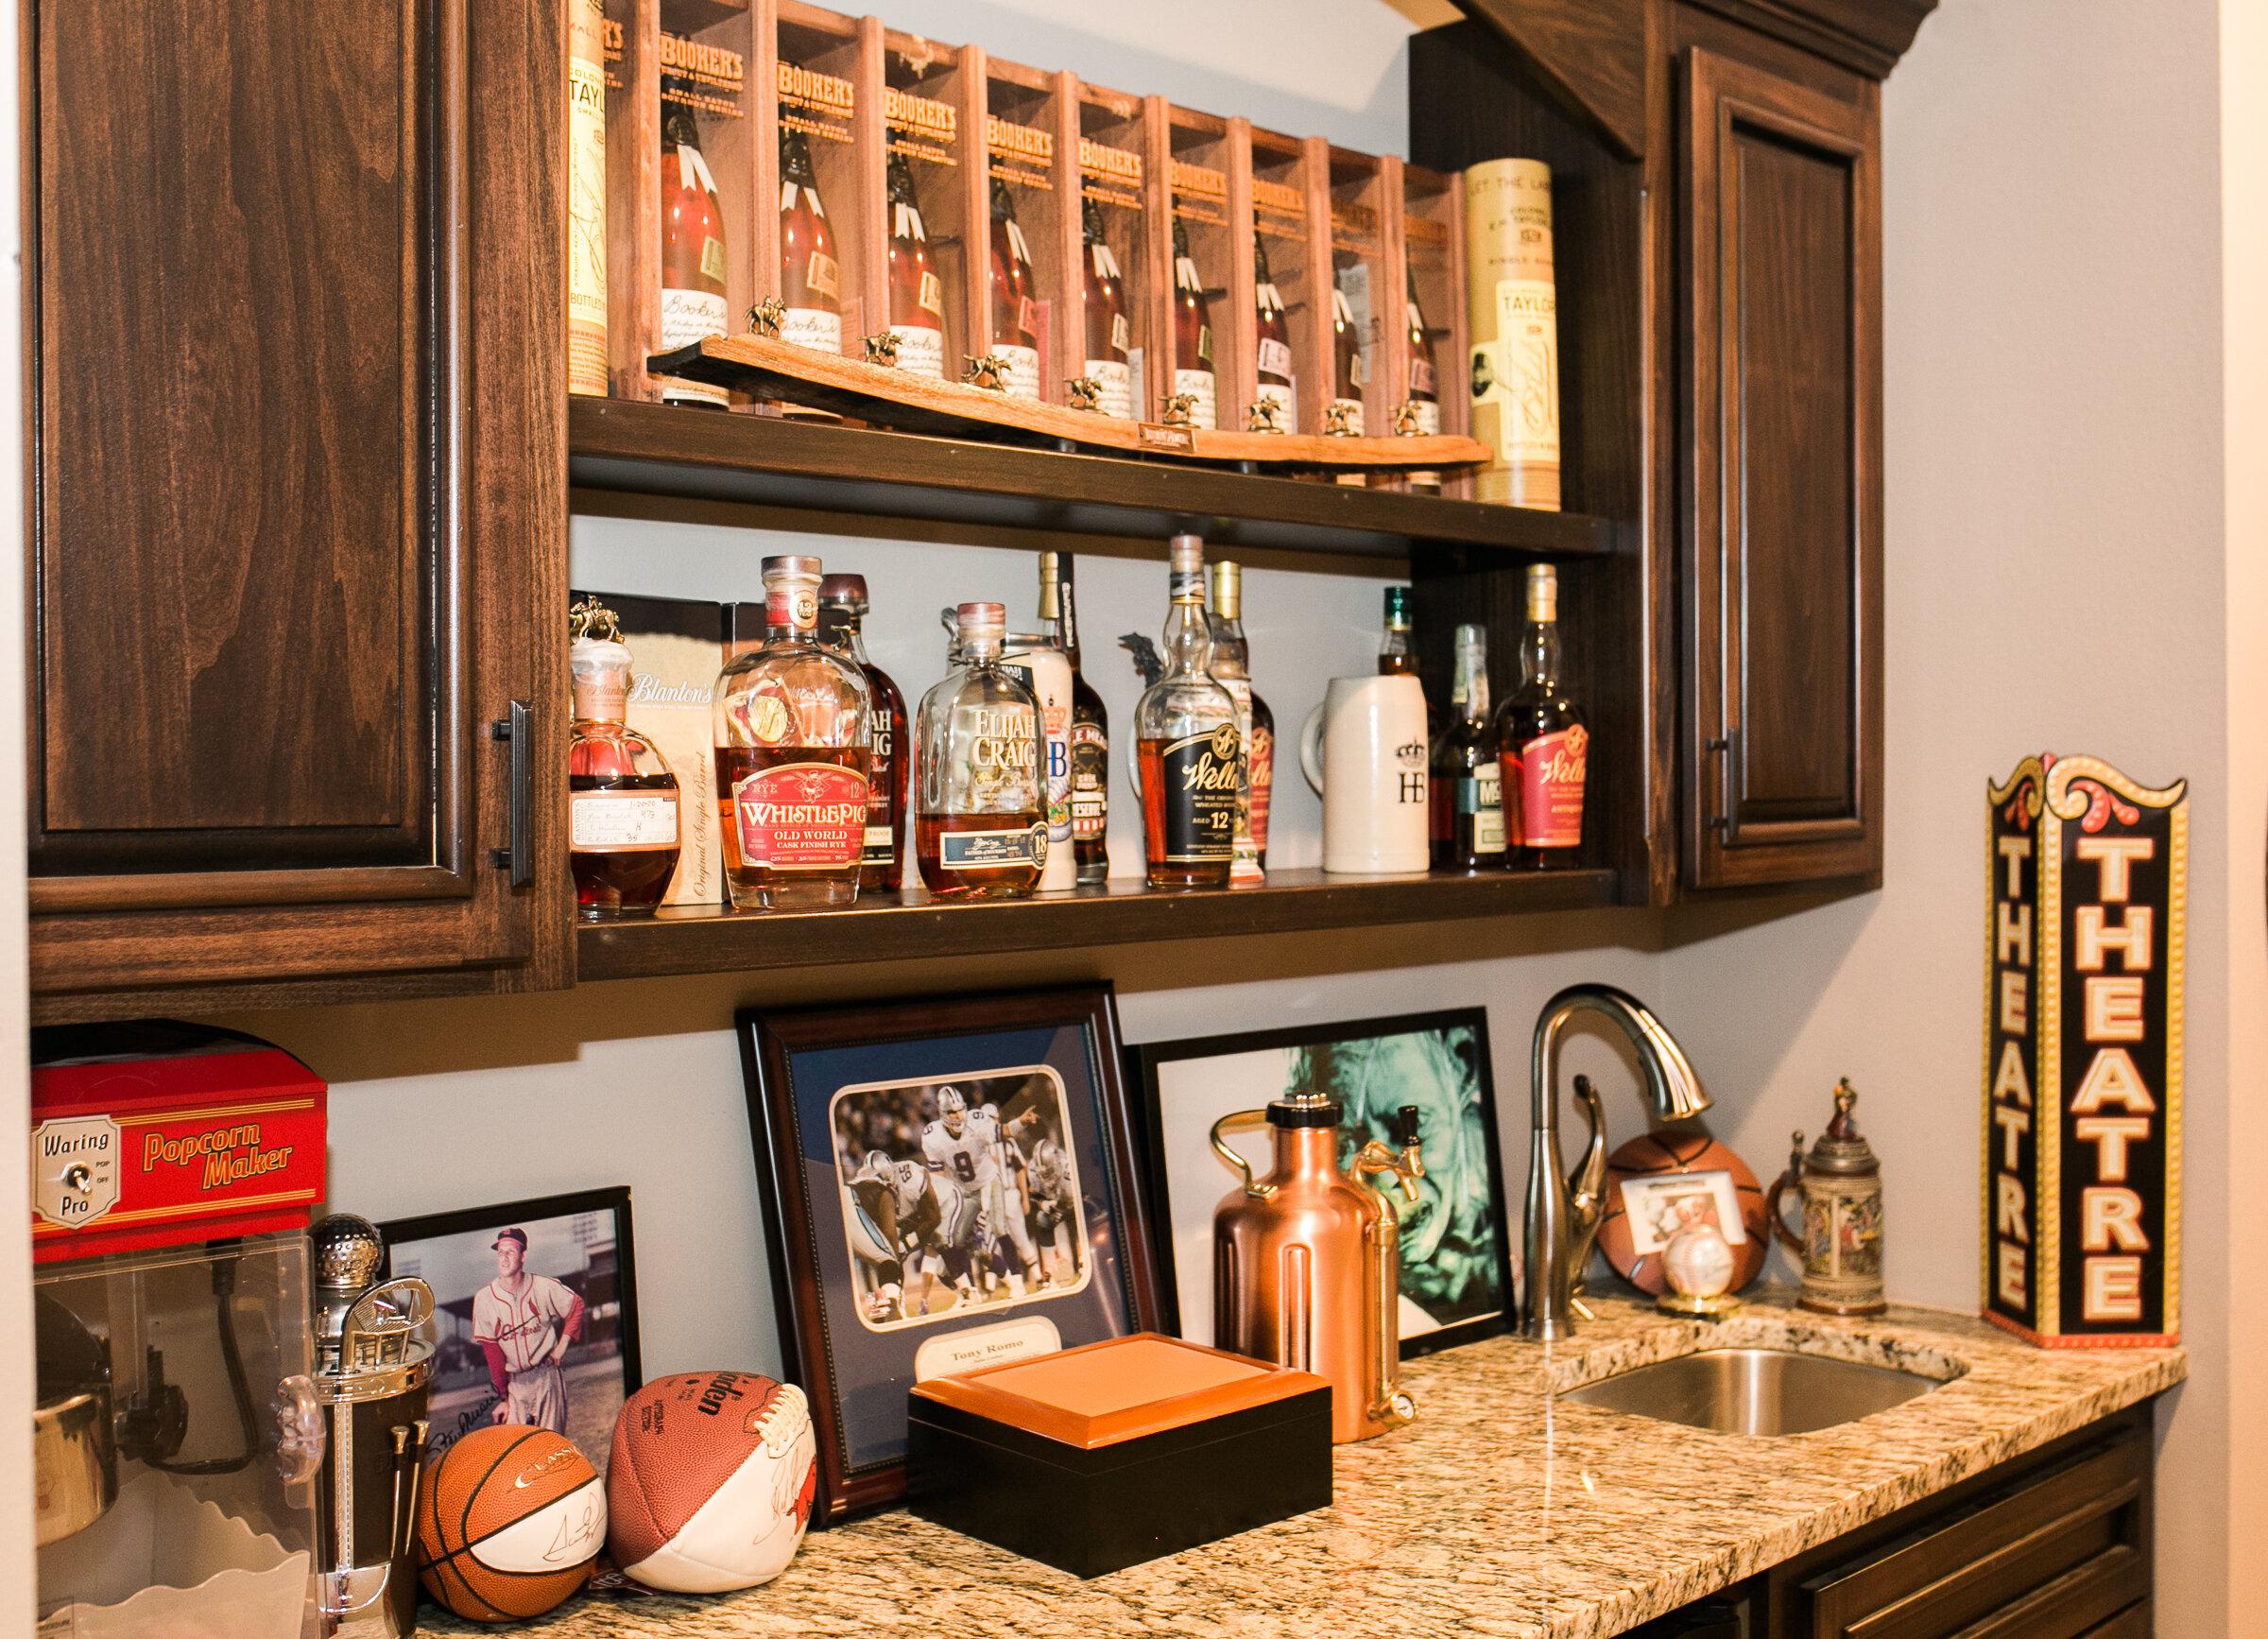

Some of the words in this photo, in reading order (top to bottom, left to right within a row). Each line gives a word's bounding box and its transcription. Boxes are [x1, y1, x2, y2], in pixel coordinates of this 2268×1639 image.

[660, 35, 743, 79] BOOKER'S
[777, 63, 854, 108] BOOKER'S
[885, 89, 956, 130] BOOKER'S
[986, 118, 1053, 158] BOOKER'S
[1078, 141, 1142, 179] BOOKER'S
[627, 672, 712, 704] Blanton's
[974, 709, 1037, 744] ELIJAH
[971, 736, 1037, 771] CRAIG
[752, 784, 778, 794] RYE
[850, 781, 861, 799] 12
[693, 802, 712, 843] Single
[774, 830, 800, 840] OLD
[803, 830, 848, 840] WORLD
[1211, 811, 1229, 829] 12
[776, 840, 799, 849] CASK
[800, 840, 828, 849] FINISH
[829, 840, 847, 849] RYE
[1034, 834, 1047, 854] 18
[693, 844, 710, 898] Original
[1993, 836, 2032, 1311] THEATRE
[2070, 837, 2156, 1321] THEATRE
[43, 1133, 109, 1157] Waring
[143, 1124, 261, 1172] Popcorn
[95, 1160, 111, 1168] POP
[96, 1176, 110, 1184] OFF
[201, 1146, 293, 1190] Maker
[899, 1164, 914, 1183] 59
[953, 1150, 976, 1182] 9
[60, 1196, 89, 1217] Pro
[952, 1349, 984, 1362] Tony
[987, 1340, 1024, 1354] Romo
